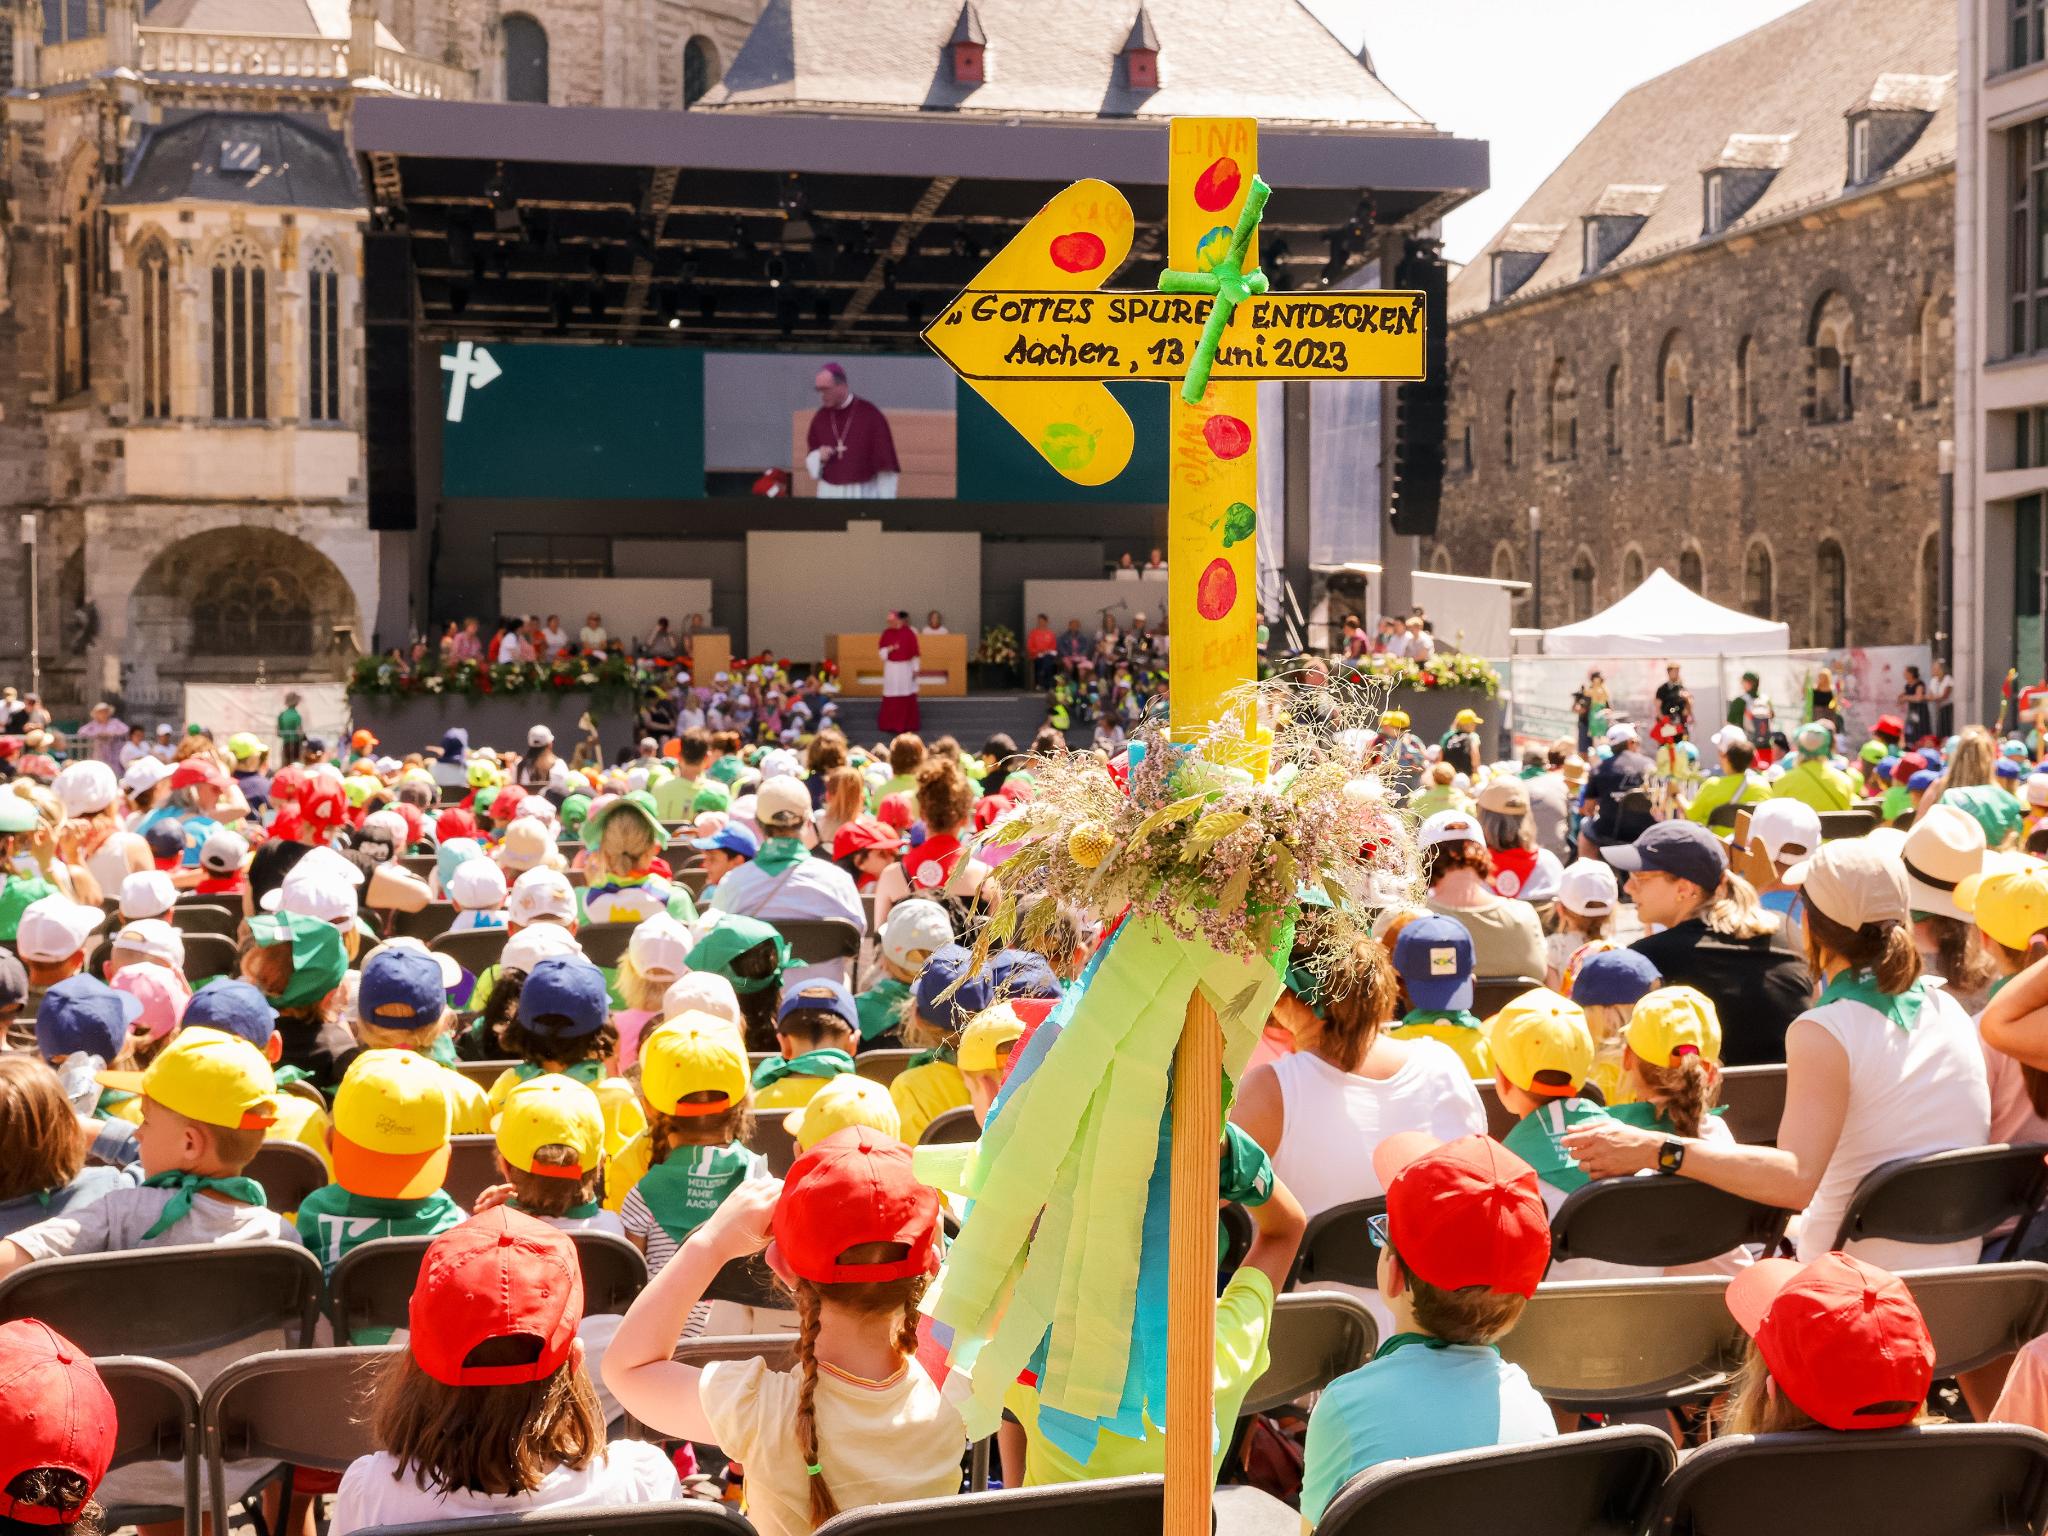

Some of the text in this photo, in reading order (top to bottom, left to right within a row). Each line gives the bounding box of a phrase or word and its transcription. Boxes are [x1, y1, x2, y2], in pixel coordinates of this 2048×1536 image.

[1172, 120, 1249, 157] LINA
[1148, 337, 1185, 365] 13
[1195, 334, 1268, 367] uni
[1273, 337, 1349, 372] 2023
